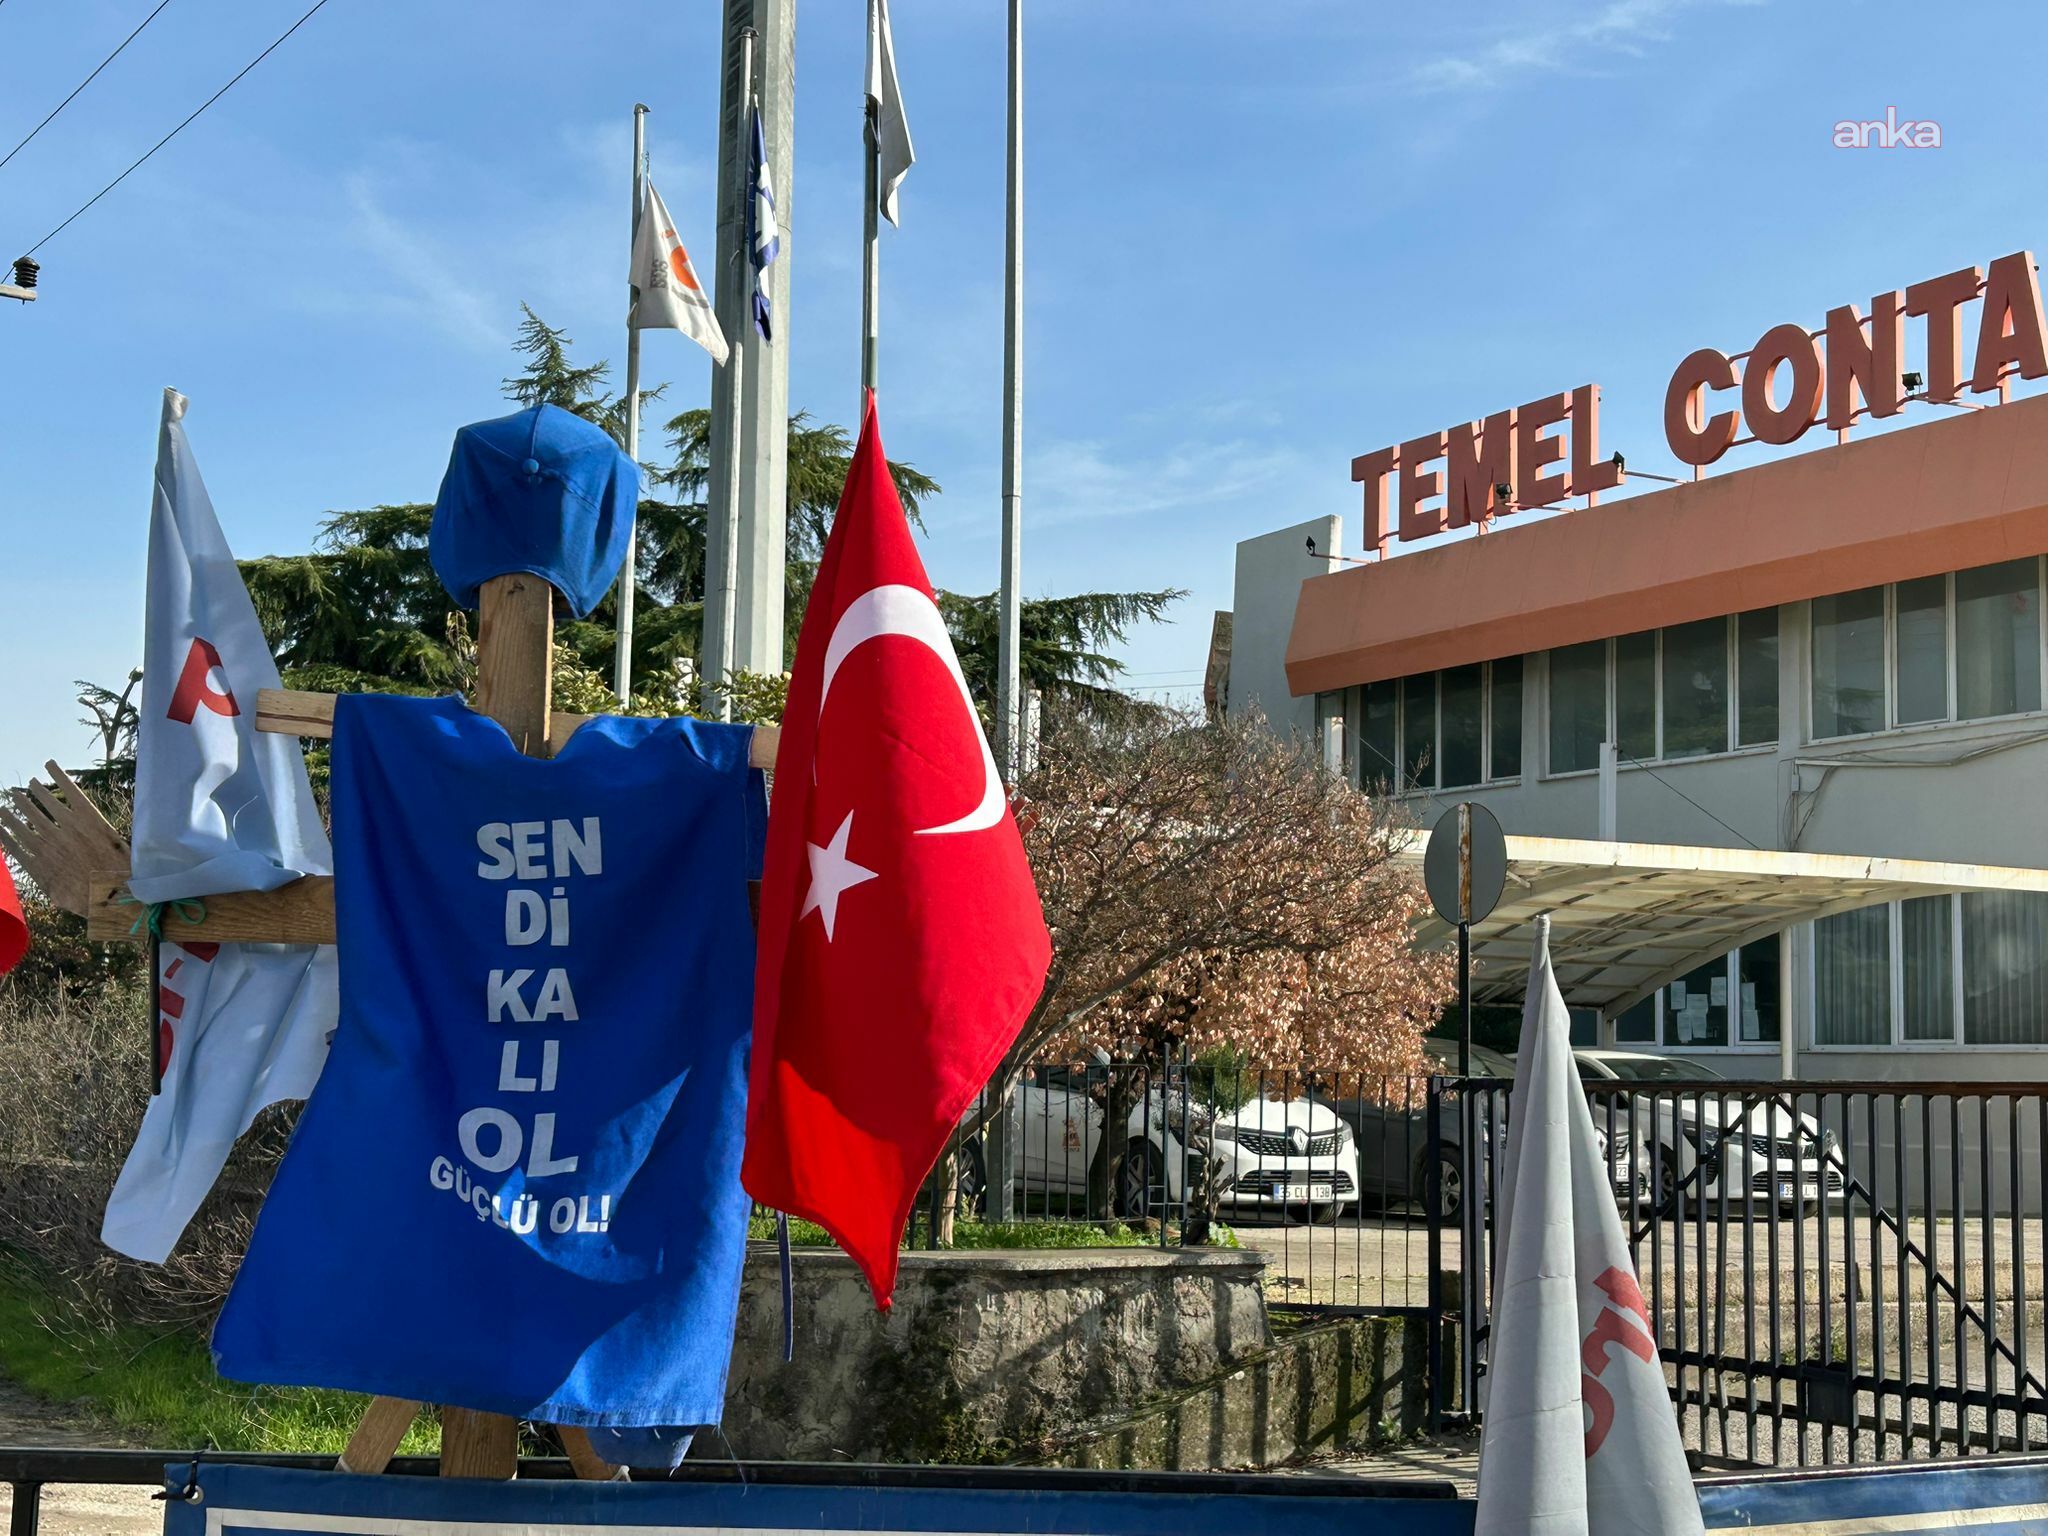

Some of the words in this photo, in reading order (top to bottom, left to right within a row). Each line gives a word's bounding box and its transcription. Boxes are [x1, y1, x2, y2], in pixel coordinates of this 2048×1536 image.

[1352, 383, 1625, 551] TEMEL
[1664, 251, 2048, 466] CONTA
[476, 816, 603, 881] SEN
[505, 886, 571, 947] Dİ
[487, 968, 580, 1023] KA
[498, 1039, 560, 1092] LI
[458, 1106, 579, 1178] OL
[430, 1155, 539, 1234] GÜÇLÜ
[549, 1194, 611, 1234] OL!
